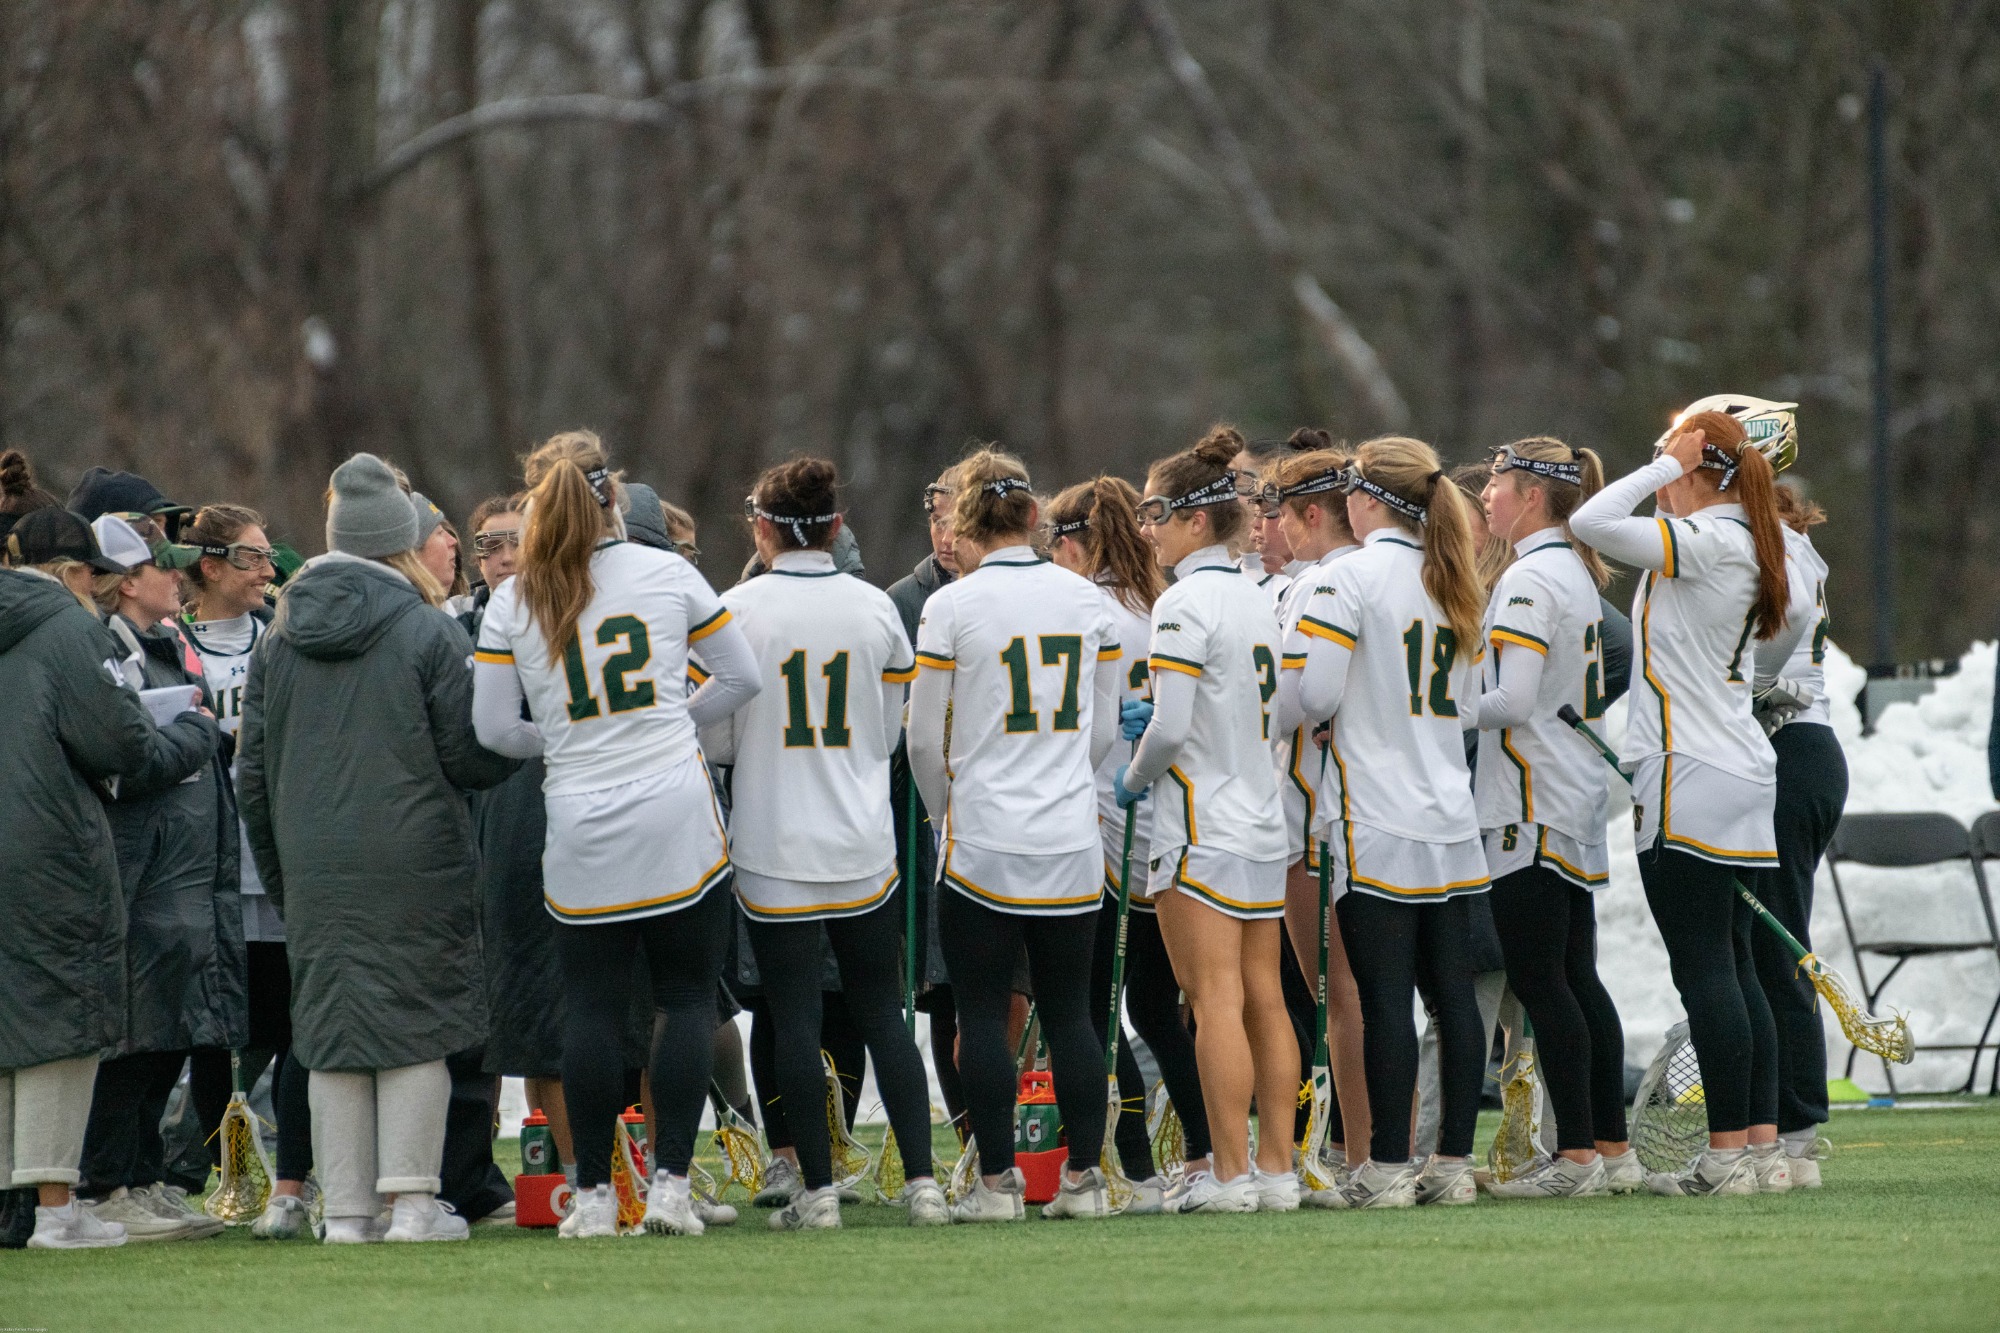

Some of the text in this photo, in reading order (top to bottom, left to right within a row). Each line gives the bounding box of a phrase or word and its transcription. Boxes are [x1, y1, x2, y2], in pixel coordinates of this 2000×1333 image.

[1745, 420, 1780, 438] AINTS
[1717, 449, 1735, 465] GAIT
[1188, 486, 1210, 500] GAIT
[1363, 481, 1384, 494] GAIT
[1384, 491, 1406, 505] GAIT
[774, 515, 795, 524] GAIT
[1062, 521, 1081, 531] GAIT
[205, 546, 226, 555] GAIT
[1313, 585, 1336, 595] MAAC
[1508, 596, 1534, 607] MAAC
[1157, 622, 1181, 633] MAAC
[561, 613, 657, 724] 12
[1403, 618, 1459, 719] 18
[1000, 634, 1082, 734] 17
[780, 648, 851, 749] 11
[1502, 823, 1518, 852] S
[1742, 891, 1766, 915] GAIT
[1318, 975, 1327, 1005] GAIT
[1026, 1118, 1042, 1143] G
[524, 1140, 544, 1165] G
